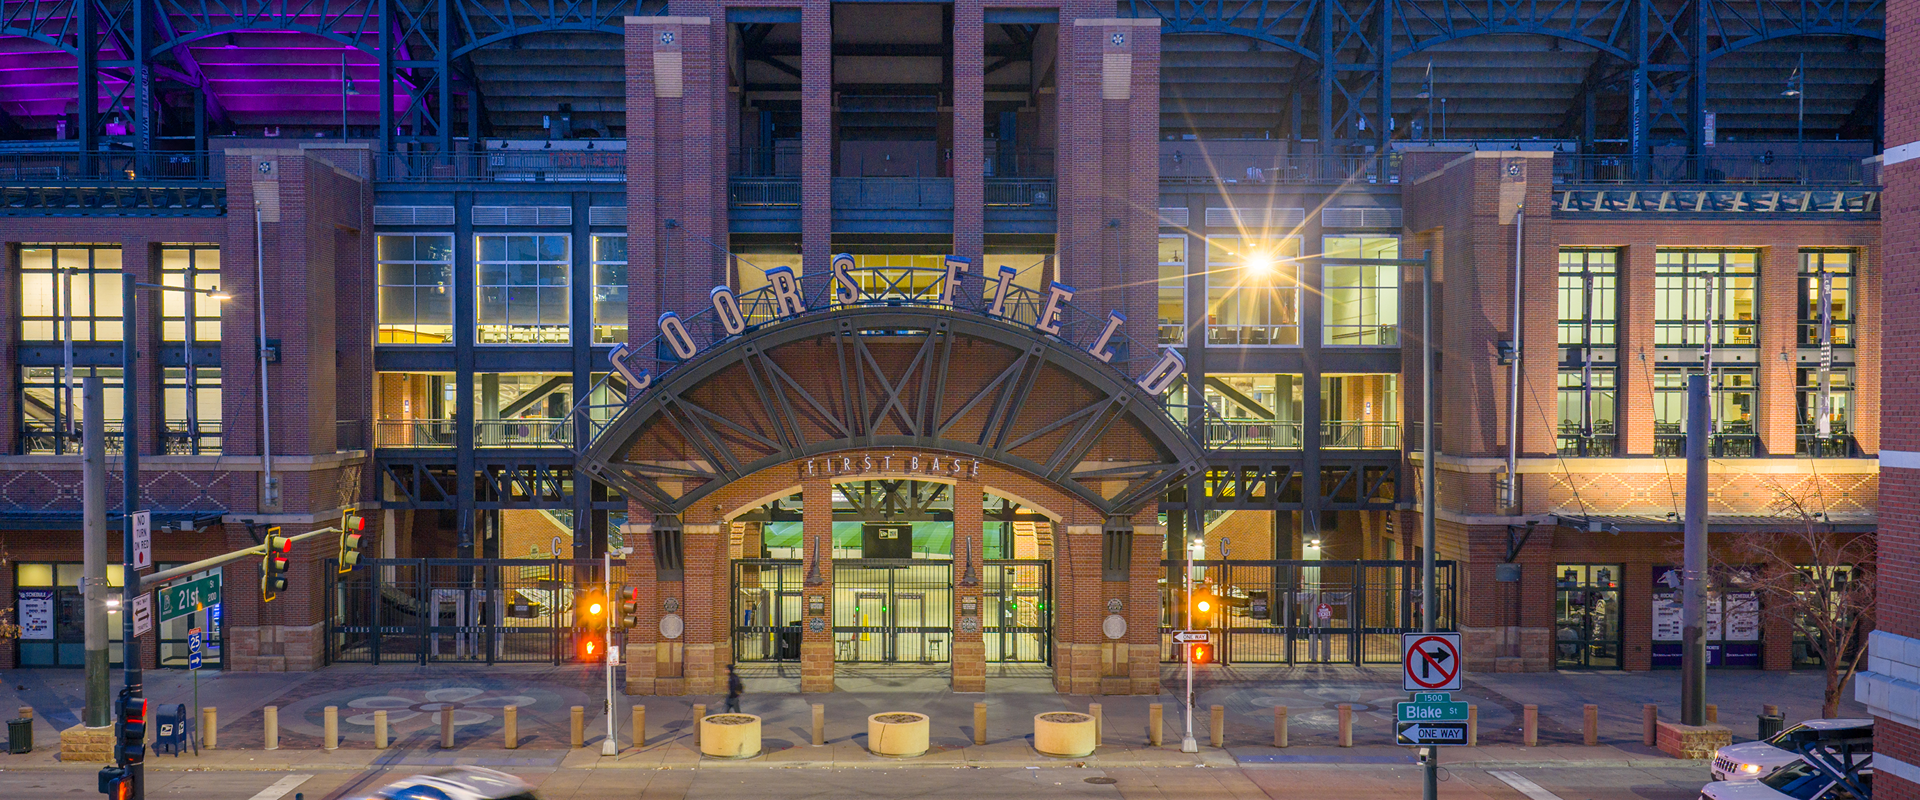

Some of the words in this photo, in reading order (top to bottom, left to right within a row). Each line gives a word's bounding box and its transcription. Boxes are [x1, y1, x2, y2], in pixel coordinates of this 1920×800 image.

[608, 252, 859, 389] COORS
[940, 254, 1187, 395] FIELD
[807, 456, 891, 475] FIRST
[912, 456, 980, 475] BASE
[137, 515, 146, 526] NO
[551, 536, 562, 556] C
[1220, 537, 1230, 557] C
[178, 587, 200, 610] 21st
[190, 635, 201, 648] 25
[1406, 706, 1442, 718] Blake
[1449, 707, 1458, 715] St
[1418, 729, 1437, 738] ONE
[1440, 729, 1461, 738] WAY
